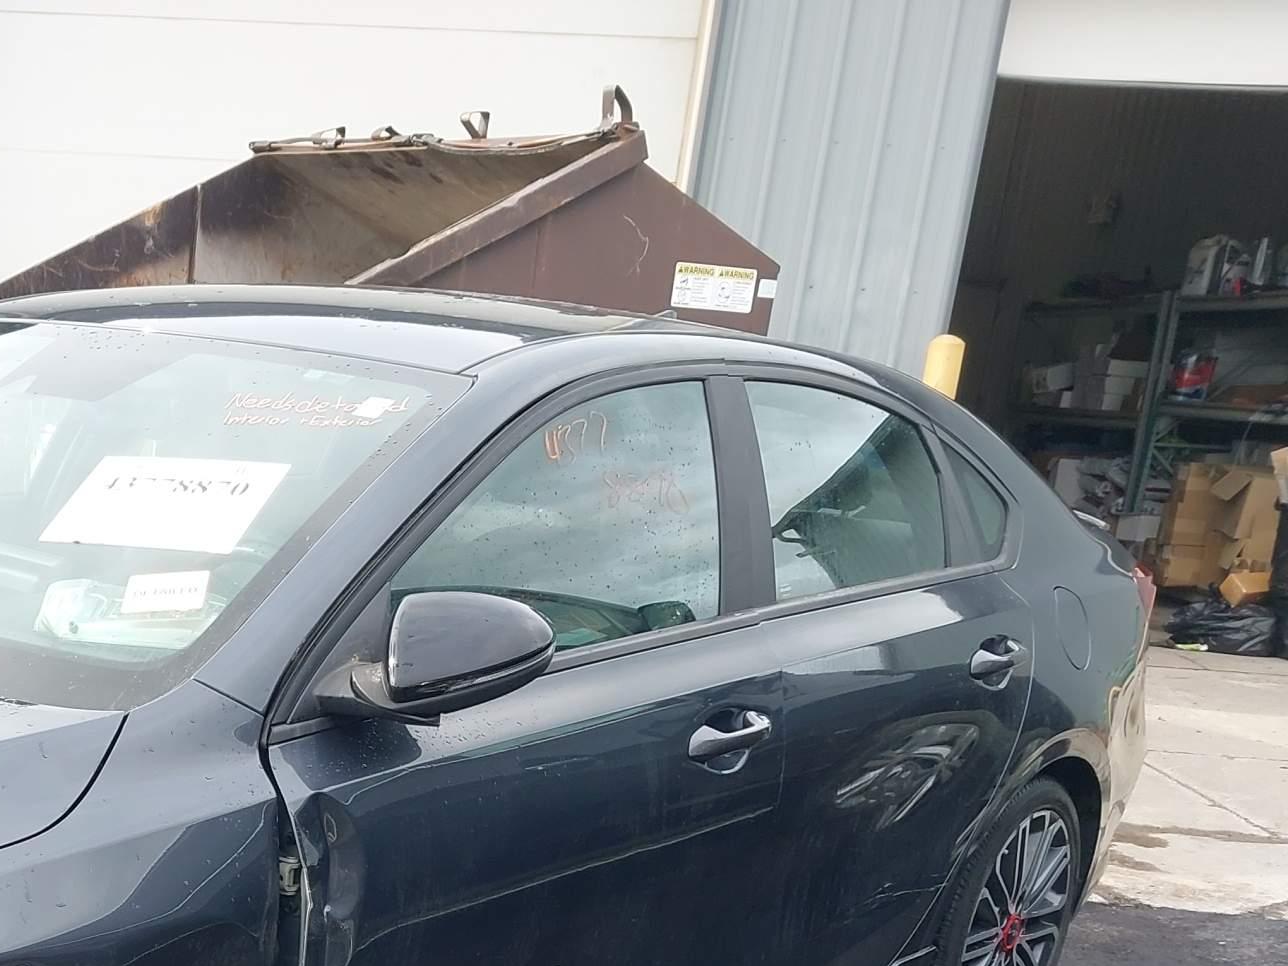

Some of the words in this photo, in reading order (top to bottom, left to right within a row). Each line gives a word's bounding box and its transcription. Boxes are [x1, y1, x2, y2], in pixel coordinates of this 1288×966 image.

[683, 265, 715, 277] WARNING
[724, 269, 755, 280] WARNING
[224, 392, 295, 411] Needs
[295, 393, 410, 415] detad
[223, 411, 290, 426] Interior
